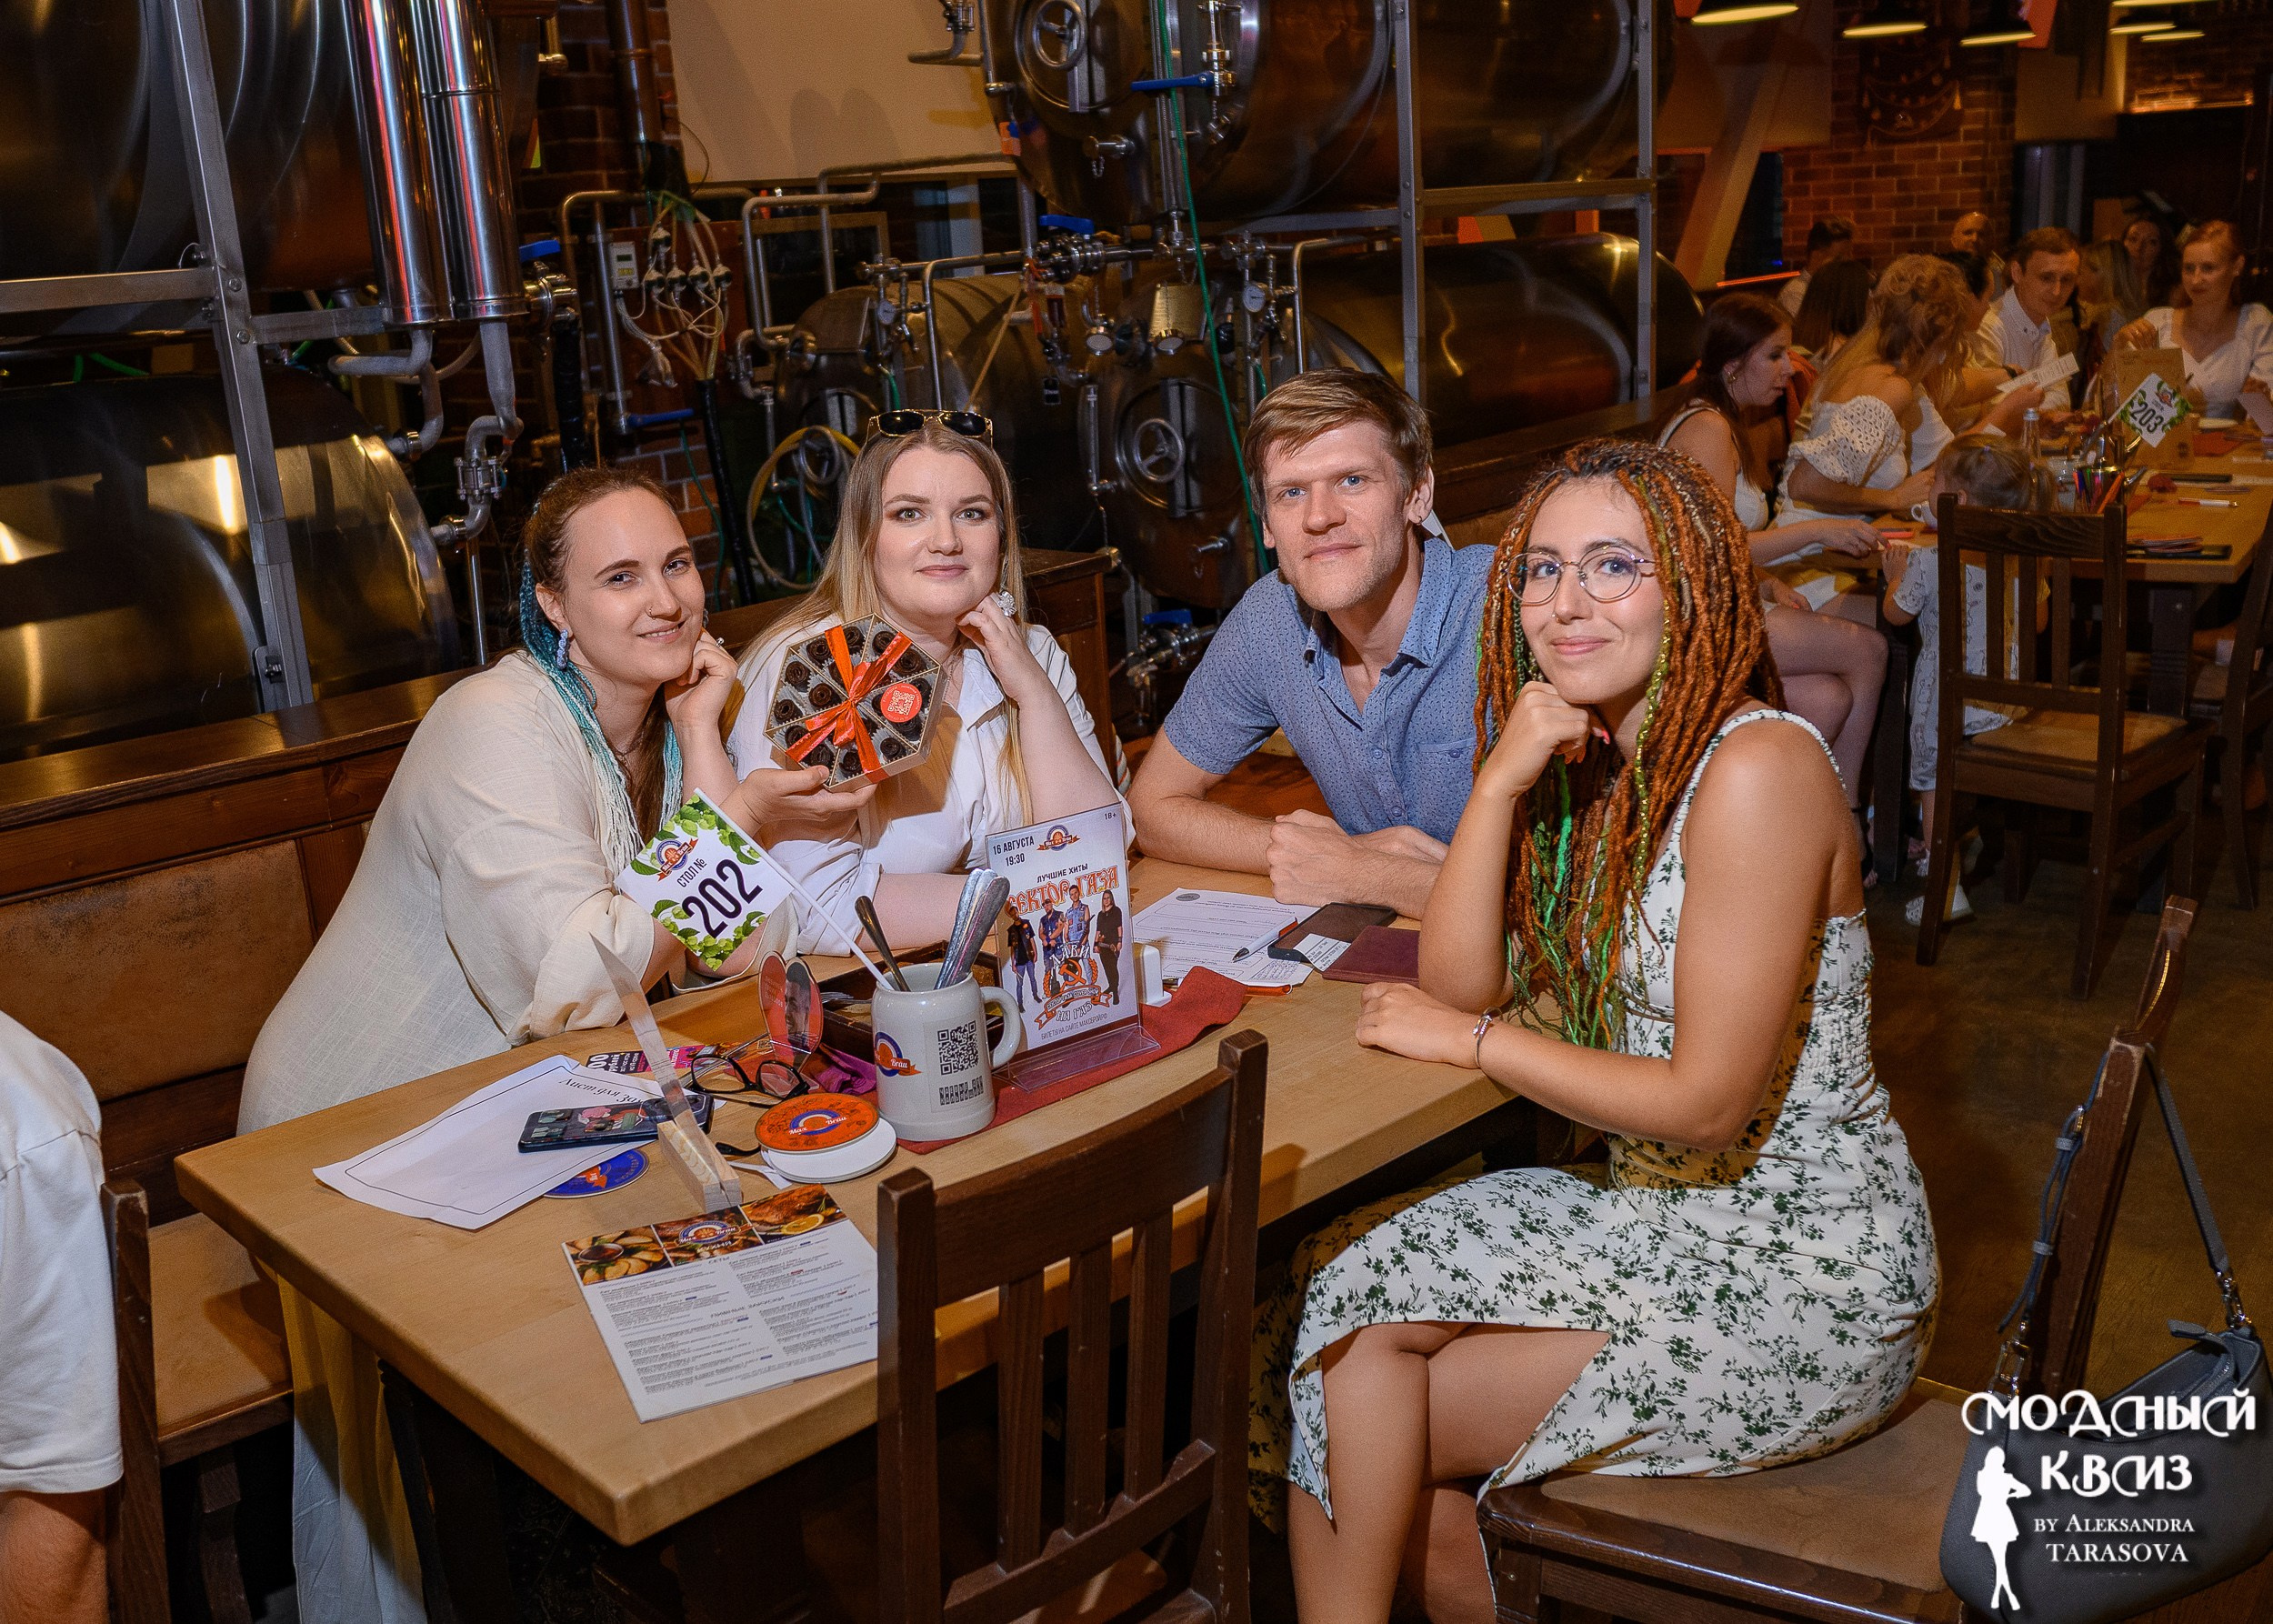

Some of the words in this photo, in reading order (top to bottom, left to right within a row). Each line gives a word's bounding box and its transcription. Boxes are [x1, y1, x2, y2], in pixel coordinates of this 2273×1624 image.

[2130, 402, 2164, 433] 203
[1104, 812, 1116, 820] 18+
[993, 845, 1001, 855] 16
[1003, 836, 1035, 853] АВГУСТА
[1005, 853, 1026, 867] 19:30
[676, 866, 699, 887] СТОЛ
[693, 857, 707, 868] №
[1036, 868, 1067, 883] ЛУЧШИЕ
[1068, 863, 1088, 875] ХИТЫ
[682, 859, 763, 938] 202
[1006, 879, 1070, 916] СЕКТОР
[1075, 865, 1120, 899] ГАЗА
[558, 1078, 596, 1091] Лист
[593, 1088, 620, 1097] для
[788, 1127, 808, 1135] Max
